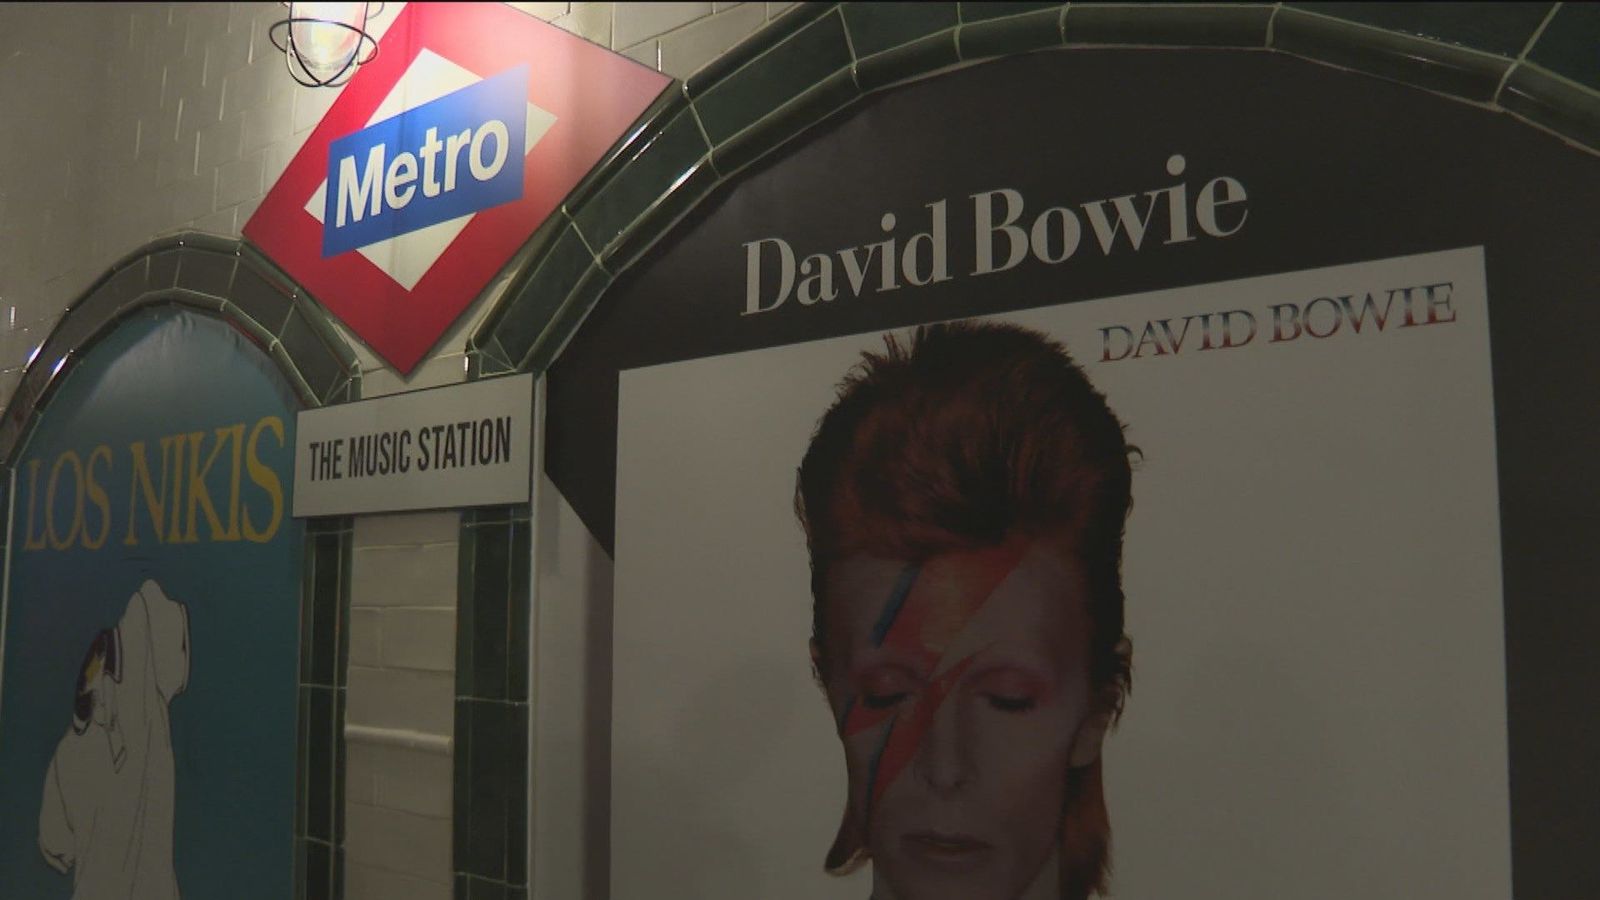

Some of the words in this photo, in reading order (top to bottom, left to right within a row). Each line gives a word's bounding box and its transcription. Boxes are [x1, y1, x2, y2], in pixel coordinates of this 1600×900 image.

[335, 118, 510, 229] Metro
[740, 198, 953, 317] David
[969, 154, 1249, 277] Bowie
[1098, 309, 1257, 363] DAVID
[1269, 282, 1457, 344] BOWIE
[22, 445, 114, 552] LOS
[124, 415, 285, 546] NIKIS
[309, 439, 343, 482] THE
[348, 428, 412, 479] MUSIC
[417, 415, 511, 472] STATION
